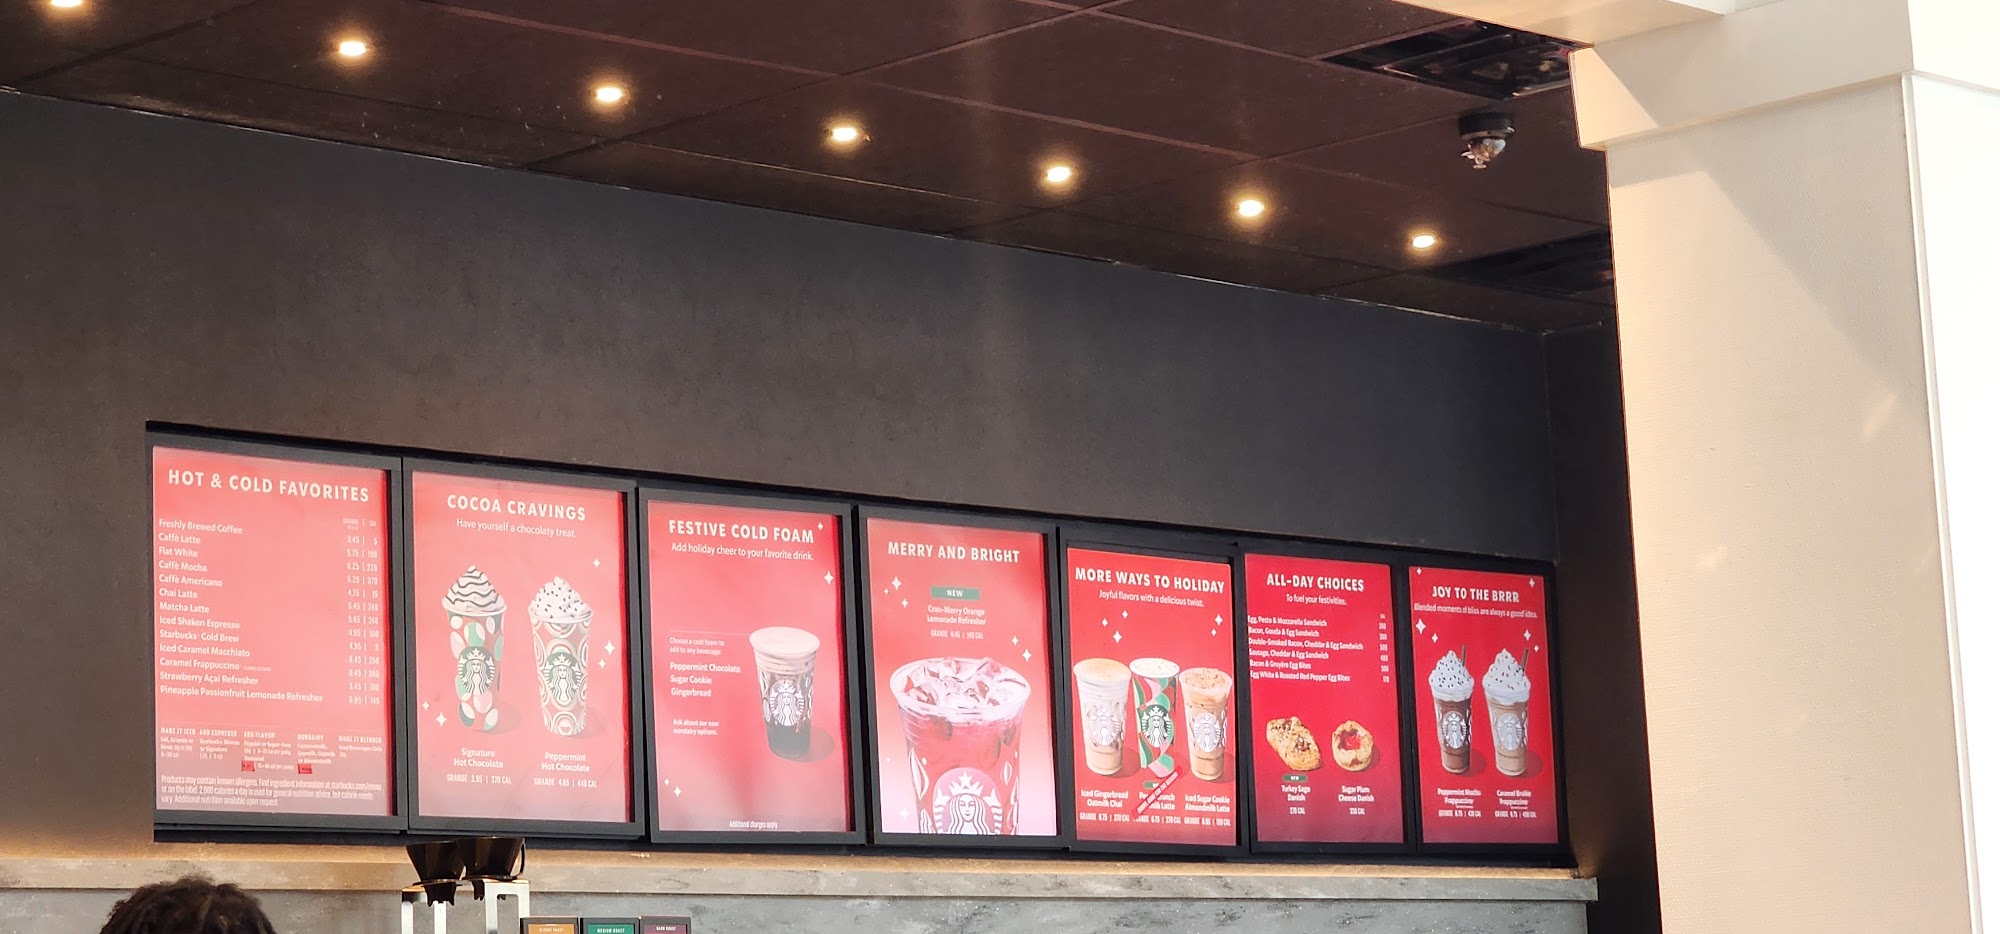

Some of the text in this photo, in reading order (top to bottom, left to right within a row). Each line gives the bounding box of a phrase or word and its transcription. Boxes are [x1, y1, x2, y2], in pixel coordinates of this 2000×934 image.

[169, 469, 368, 502] HOT & COLD FAVORITES
[447, 495, 586, 521] COCOA CRAVINGS
[159, 519, 242, 534] Freshly Brewed Coffee
[456, 518, 476, 529] Have
[478, 522, 508, 532] yourself
[517, 525, 554, 538] chocolaty
[556, 529, 576, 538] treat.
[669, 520, 814, 543] FESTIVE COLD FOAM
[159, 533, 200, 544] Caffè Latte
[159, 547, 198, 557] Flat White
[672, 542, 813, 560] Add holiday cheer to your favorite drink.
[888, 541, 1020, 563] MERRY AND BRIGHT
[159, 560, 207, 572] Caffè Mocha
[159, 574, 222, 586] Caffè Americano
[1075, 567, 1224, 594] MORE WAYS TO HOLIDAY
[1267, 573, 1364, 591] ALL-DAY CHOICES
[159, 588, 198, 598] Chai Latte
[1099, 590, 1117, 599] Joyful
[1119, 592, 1140, 601] flavors
[1140, 594, 1153, 602] with
[1160, 596, 1186, 605] delicious
[1187, 598, 1204, 607] twist.
[1432, 586, 1519, 602] JOY TO THE BRRR
[1286, 594, 1292, 602] To
[1294, 594, 1304, 602] fuel
[1319, 596, 1346, 605] festivities.
[160, 602, 209, 613] Matcha Latte
[928, 605, 984, 617] Cran-Merry Orange
[1414, 603, 1436, 612] Blended
[1468, 606, 1479, 614] bliss
[1490, 608, 1506, 616] always
[1511, 610, 1524, 618] good
[1525, 610, 1537, 618] idea.
[160, 616, 240, 629] Iced Shaken Espresso
[927, 615, 986, 625] Lemonade Refresher
[160, 630, 239, 642] Starbucks Cold Brew
[1286, 629, 1295, 637] Egg
[1296, 629, 1319, 637] Sandwich
[1249, 637, 1287, 646] Double-Smoked
[1288, 640, 1304, 648] Bacon,
[1304, 640, 1325, 648] Cheddar
[1331, 642, 1339, 650] Egg
[1340, 642, 1363, 650] Sandwich
[160, 643, 250, 656] Iced Caramel Macchiato
[1249, 648, 1270, 657] Sausage,
[1270, 650, 1291, 658] Cheddar
[160, 658, 191, 667] Caramel
[194, 660, 239, 670] Frappuccino
[670, 662, 741, 672] Peppermint Chocolate
[1290, 662, 1298, 670] Egg
[160, 671, 202, 683] Strawberry
[222, 675, 258, 684] Refresher
[671, 675, 712, 684] Sugar Cookie
[160, 685, 322, 701] Pineapple Passionfruit Lemonade Refresher
[671, 688, 711, 697] Gingerbread
[461, 748, 495, 757] Signature
[545, 752, 586, 762] Peppermint
[454, 758, 503, 768] Hot Chocolate
[541, 762, 590, 772] Hot Chocolate
[1081, 789, 1128, 799] Iced Gingerbread
[1281, 785, 1297, 793] Turkey
[1342, 786, 1356, 794] Sugar
[1087, 799, 1123, 808] Oatmilk Chai
[1185, 794, 1196, 802] Iced
[1197, 795, 1211, 803] Sugar
[1185, 803, 1216, 812] Almondmilk
